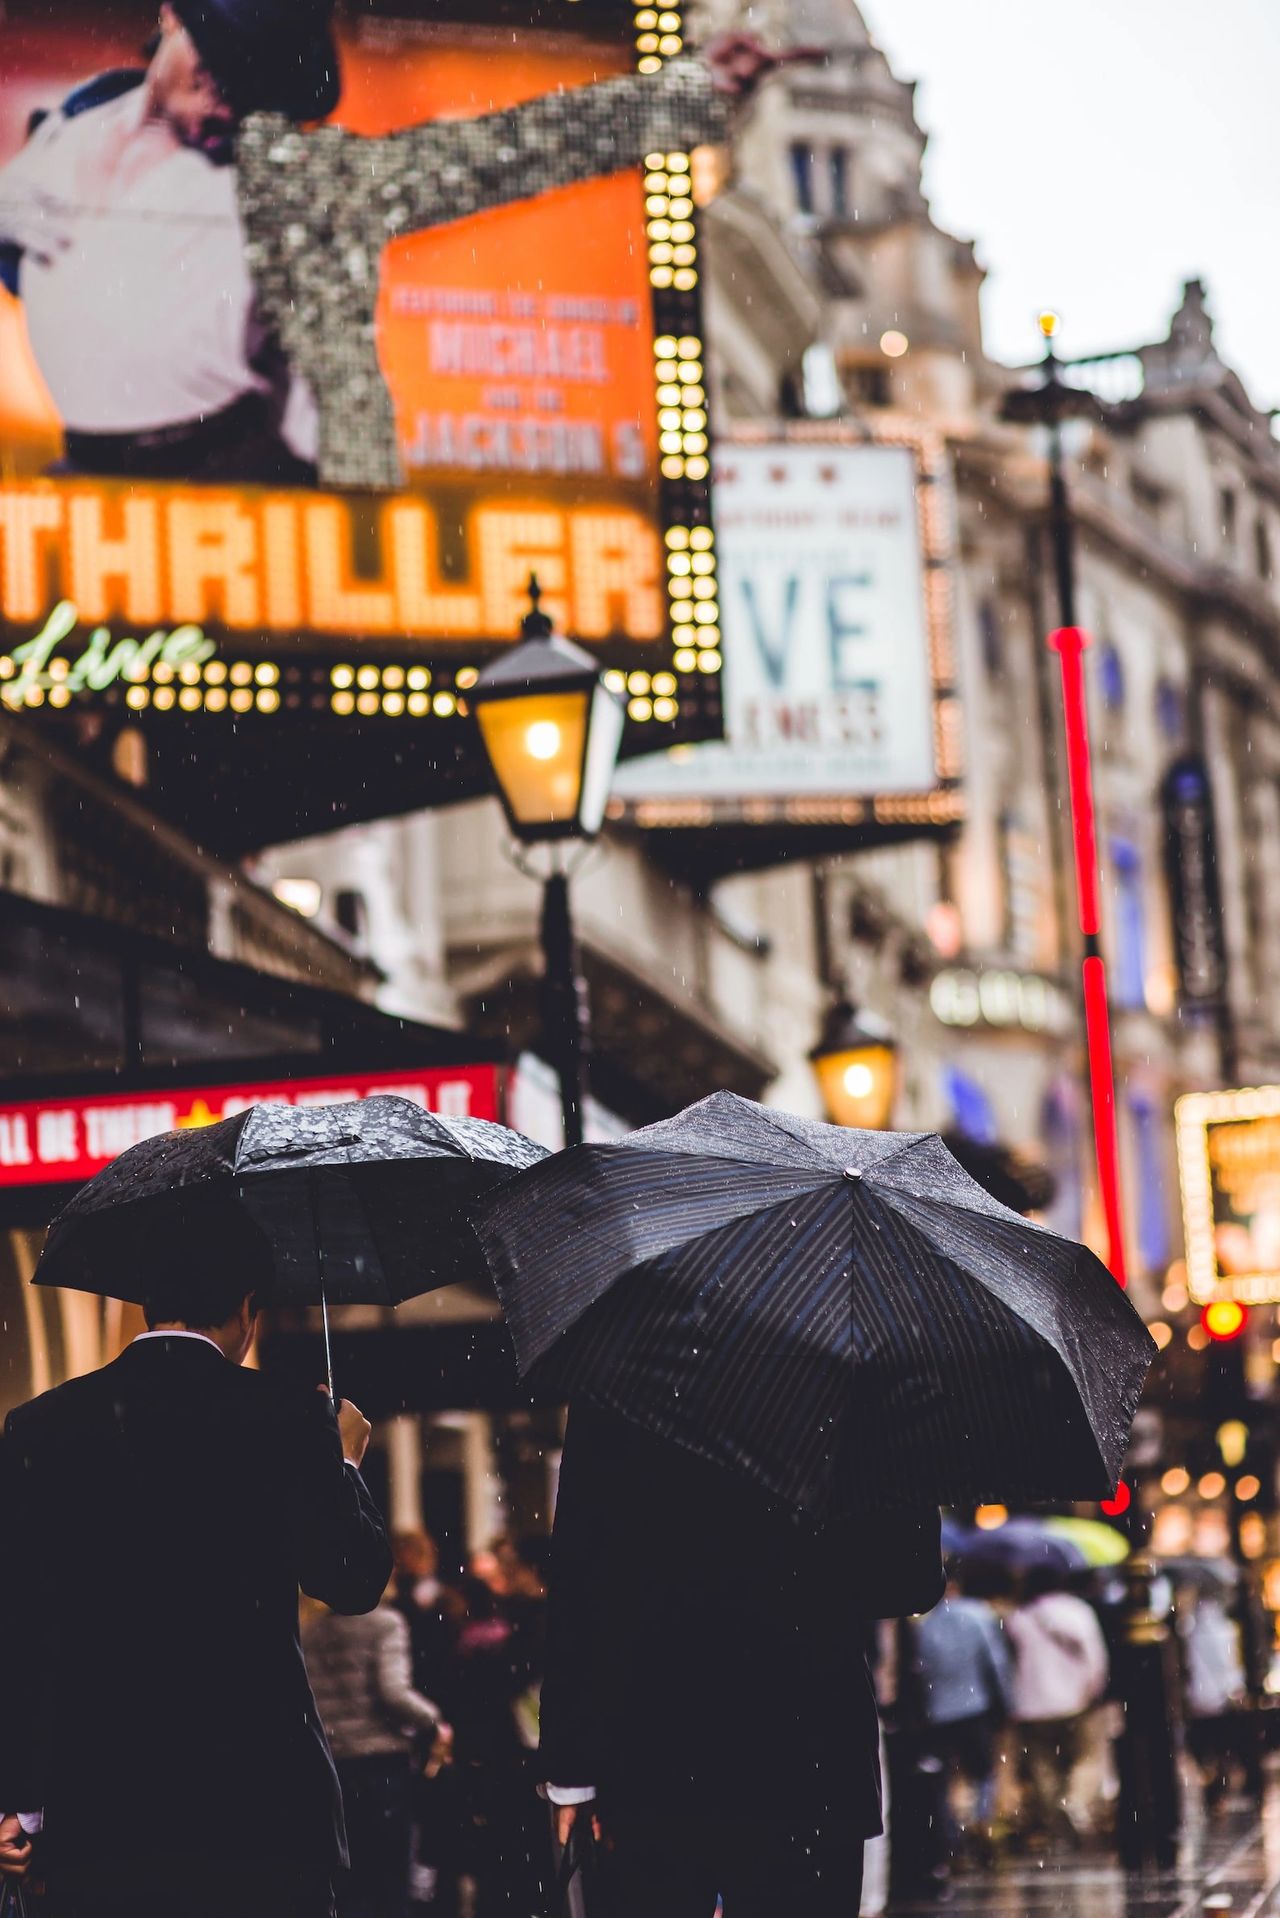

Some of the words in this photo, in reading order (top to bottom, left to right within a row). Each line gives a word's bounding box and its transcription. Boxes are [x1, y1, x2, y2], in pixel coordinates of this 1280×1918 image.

[429, 321, 608, 384] MICHAEL
[408, 413, 603, 472] JACKSON
[0, 490, 664, 640] THRILLER
